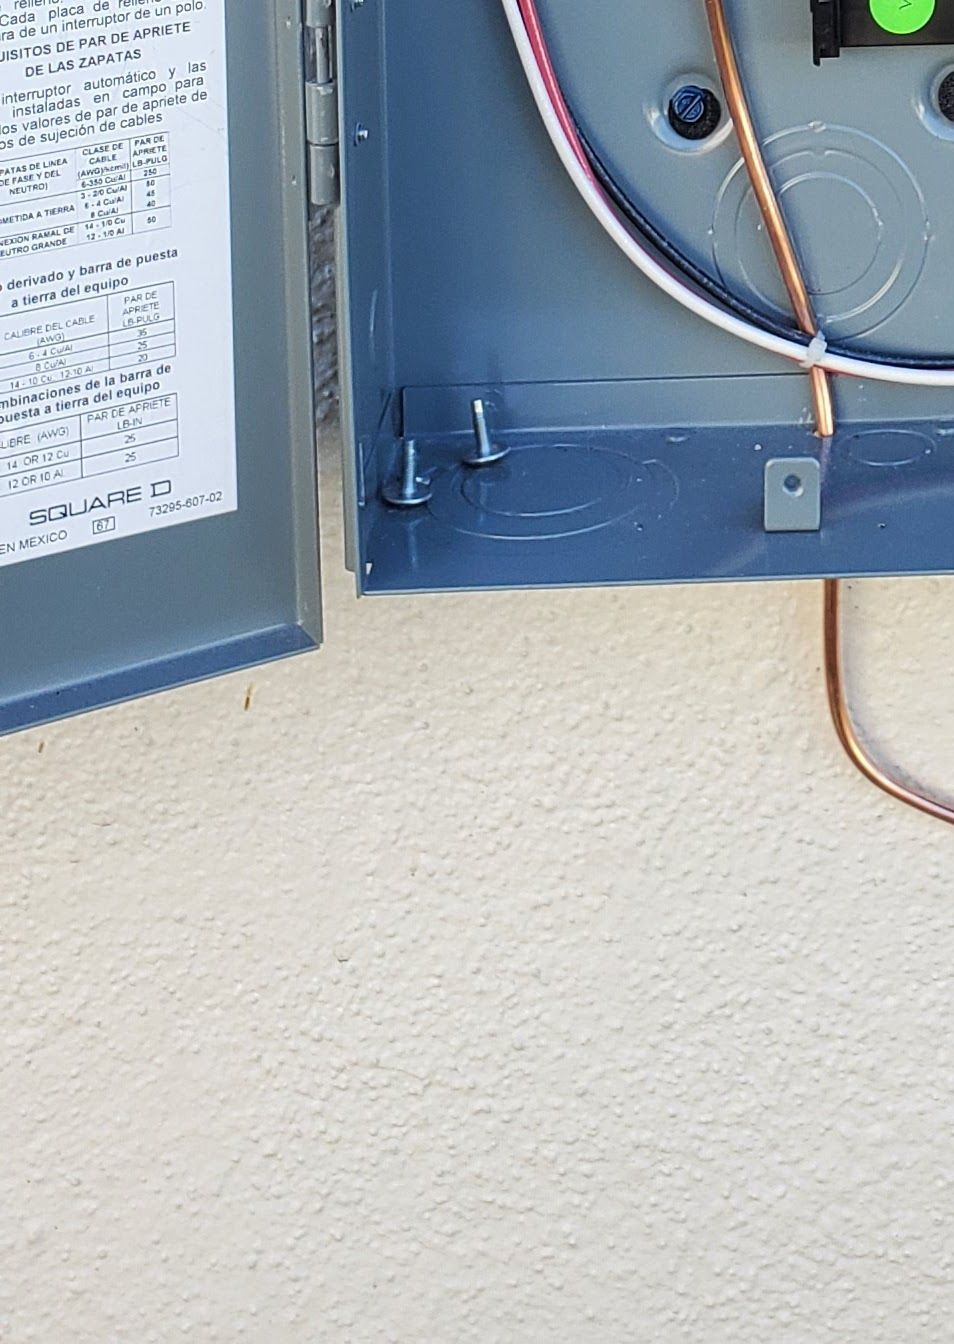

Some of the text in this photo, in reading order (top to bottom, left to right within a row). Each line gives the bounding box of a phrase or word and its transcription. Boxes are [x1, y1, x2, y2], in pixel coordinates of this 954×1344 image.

[56, 41, 75, 53] DE
[79, 35, 106, 49] PAR
[111, 31, 129, 44] DE
[133, 22, 191, 40] APRIETE
[25, 50, 141, 77] DE LAS ZAPATAS
[19, 530, 67, 549] MEXICO
[97, 519, 110, 530] 67
[150, 491, 222, 517] 73295-607-02
[30, 480, 171, 526] SQUARE D
